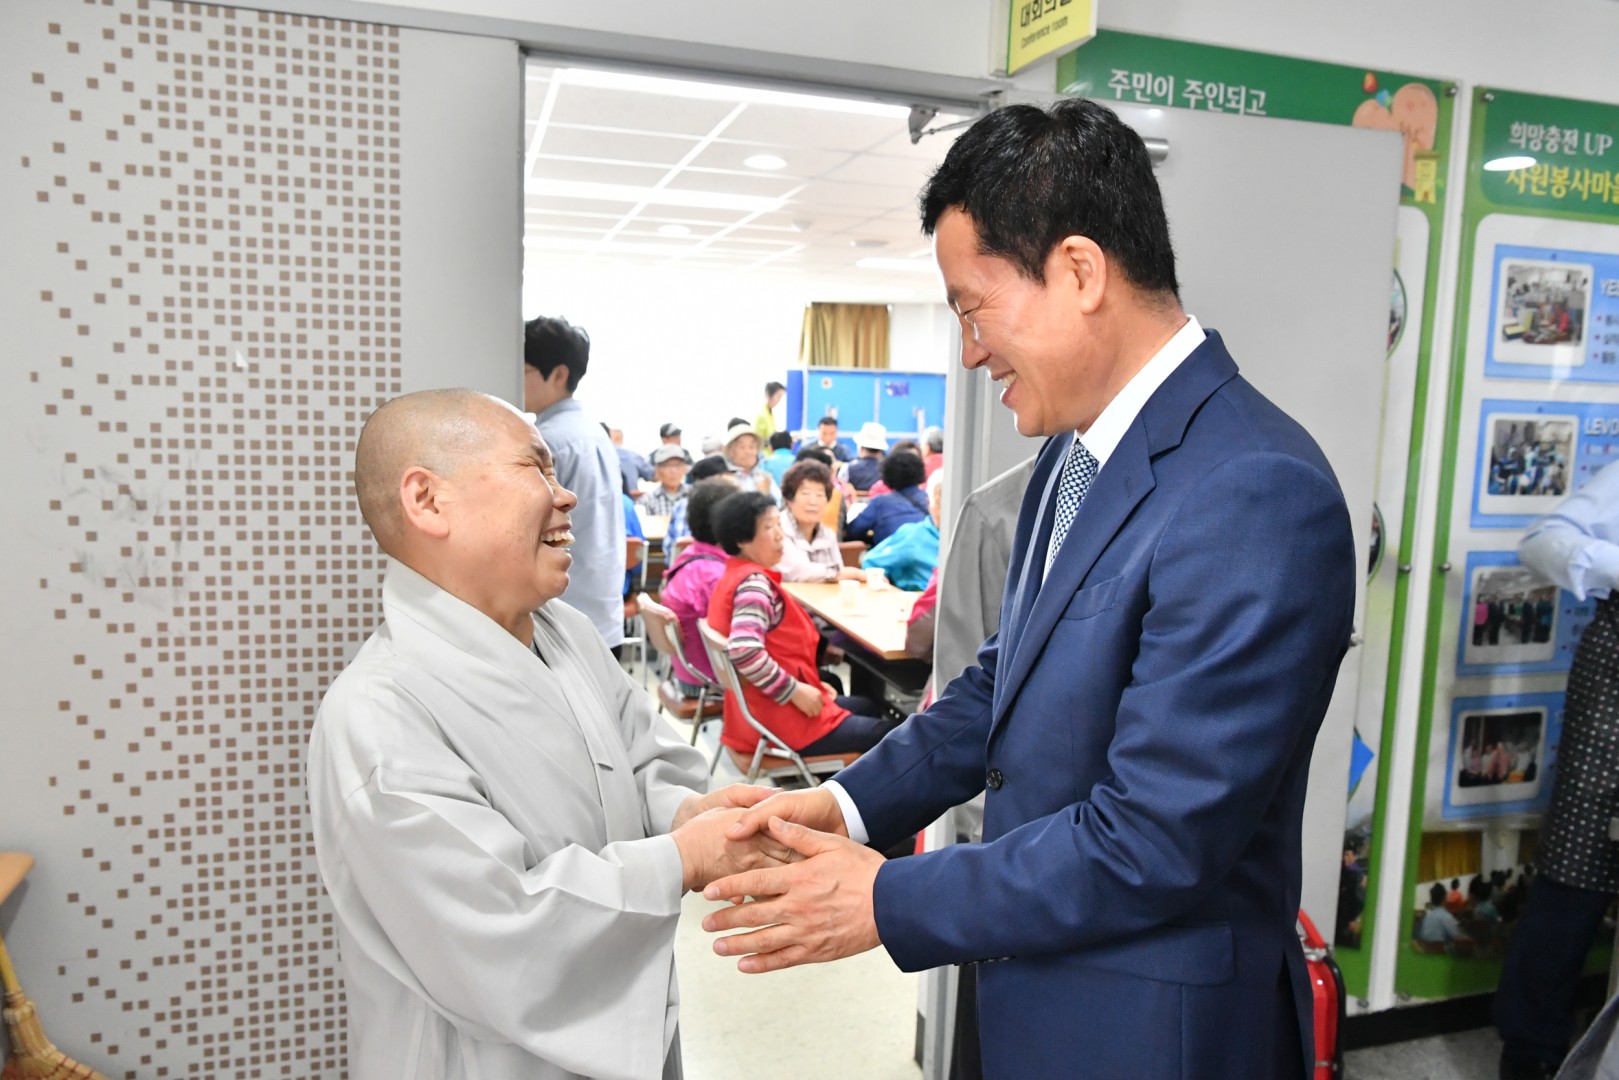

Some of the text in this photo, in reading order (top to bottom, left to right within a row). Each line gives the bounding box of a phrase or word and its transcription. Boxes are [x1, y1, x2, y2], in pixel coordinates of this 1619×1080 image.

[1021, 0, 1072, 27] 대회의
[1108, 69, 1267, 115] 주민이 주인되고
[1509, 121, 1613, 156] 희망충전 UP
